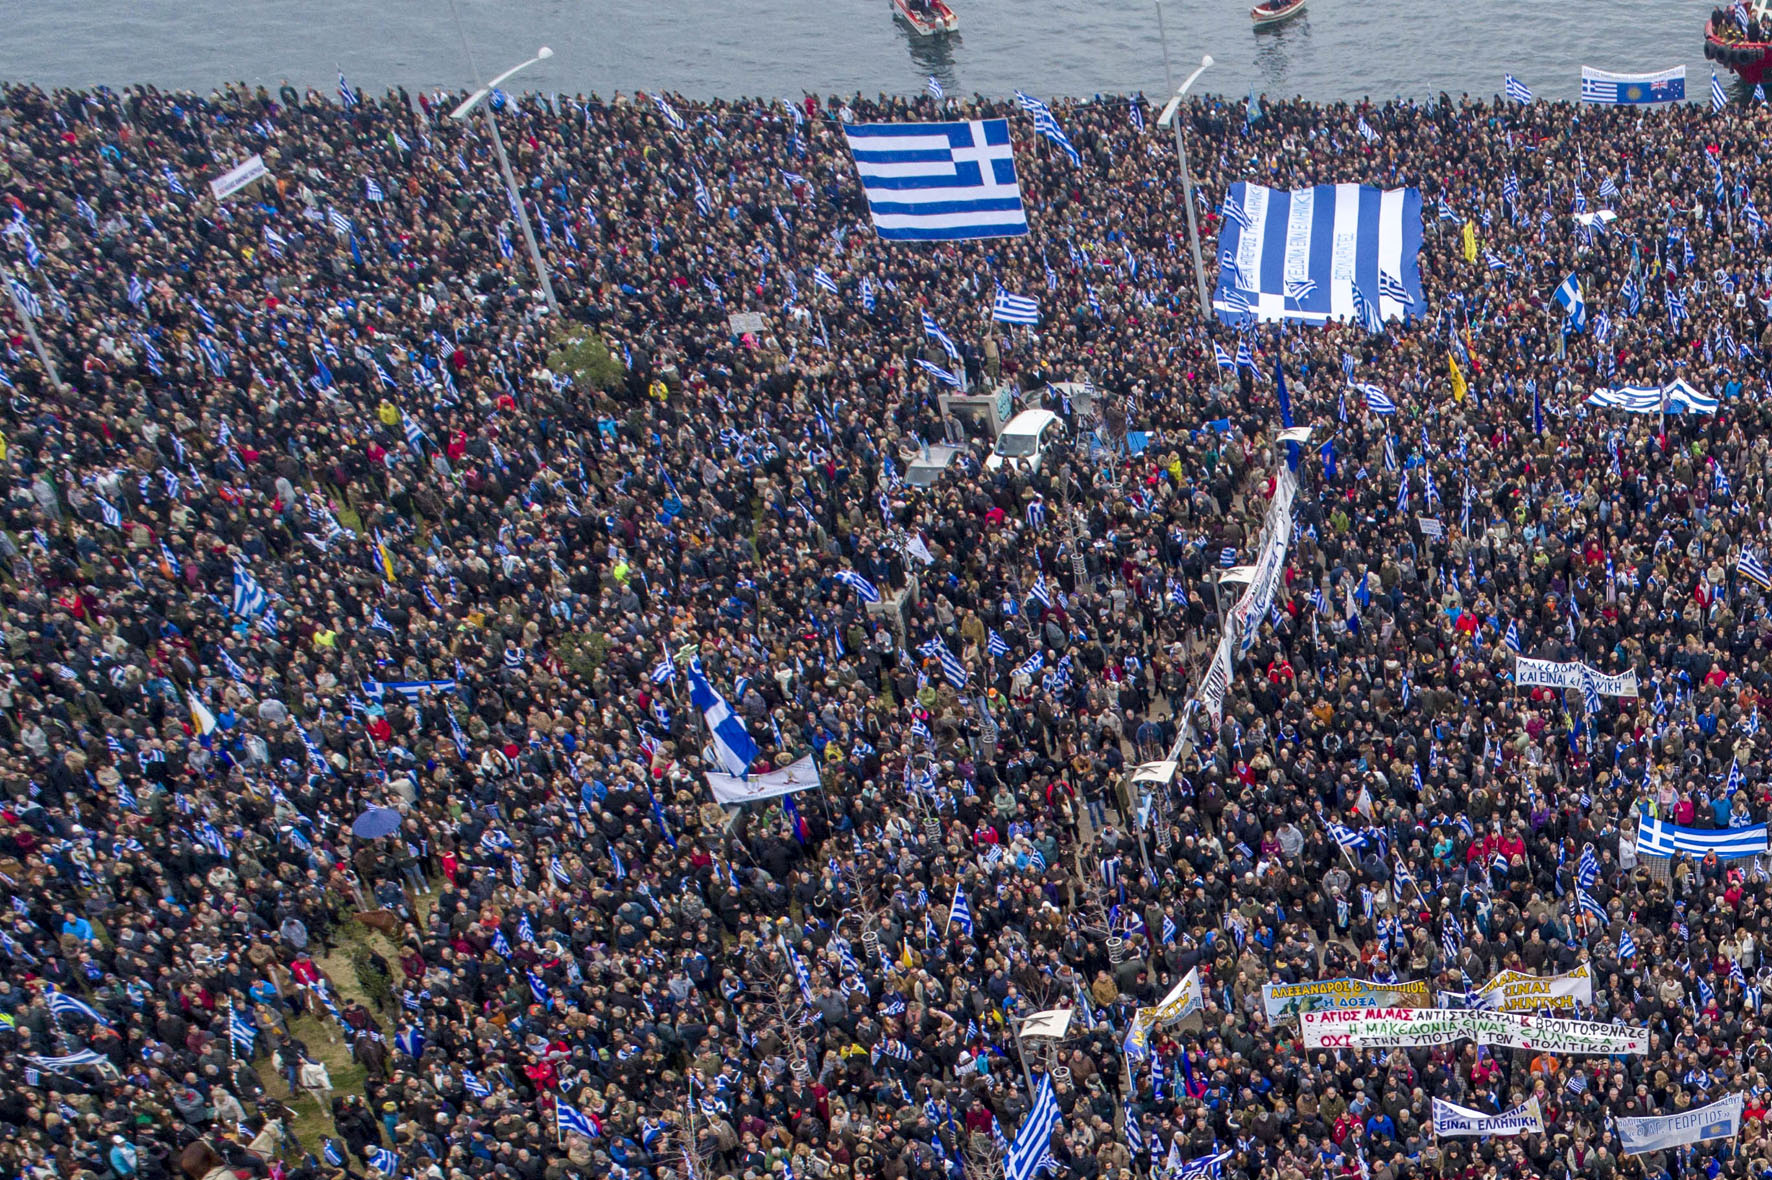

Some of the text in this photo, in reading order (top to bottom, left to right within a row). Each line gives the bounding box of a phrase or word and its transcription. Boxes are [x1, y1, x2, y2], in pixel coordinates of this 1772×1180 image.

[1519, 671, 1538, 683] ΚΑΙ
[1540, 672, 1567, 685] ΕΙΝΑΙ
[1271, 980, 1351, 999] ΑΛΕΞΑΝΔΡΟΣ
[1338, 997, 1378, 1008] ΔΟΞΑ
[1304, 1013, 1315, 1024] Ο
[1320, 1009, 1361, 1023] ΑΓΙΟΣ
[1364, 1008, 1414, 1022] ΜΑΜΑΣ
[1366, 1021, 1458, 1036] ΜΑΚΕΔΟΝΙΑ
[1463, 1018, 1508, 1034] ΕΙΝΑΙ
[1320, 1034, 1353, 1048] ΟΧΙ
[1359, 1036, 1400, 1047] ΣΤΗΝ
[1485, 1032, 1514, 1045] ΤΩΝ
[1439, 1116, 1538, 1131] ΕΙΝΑΙ ΕΛΛΗΝΙΚΗ
